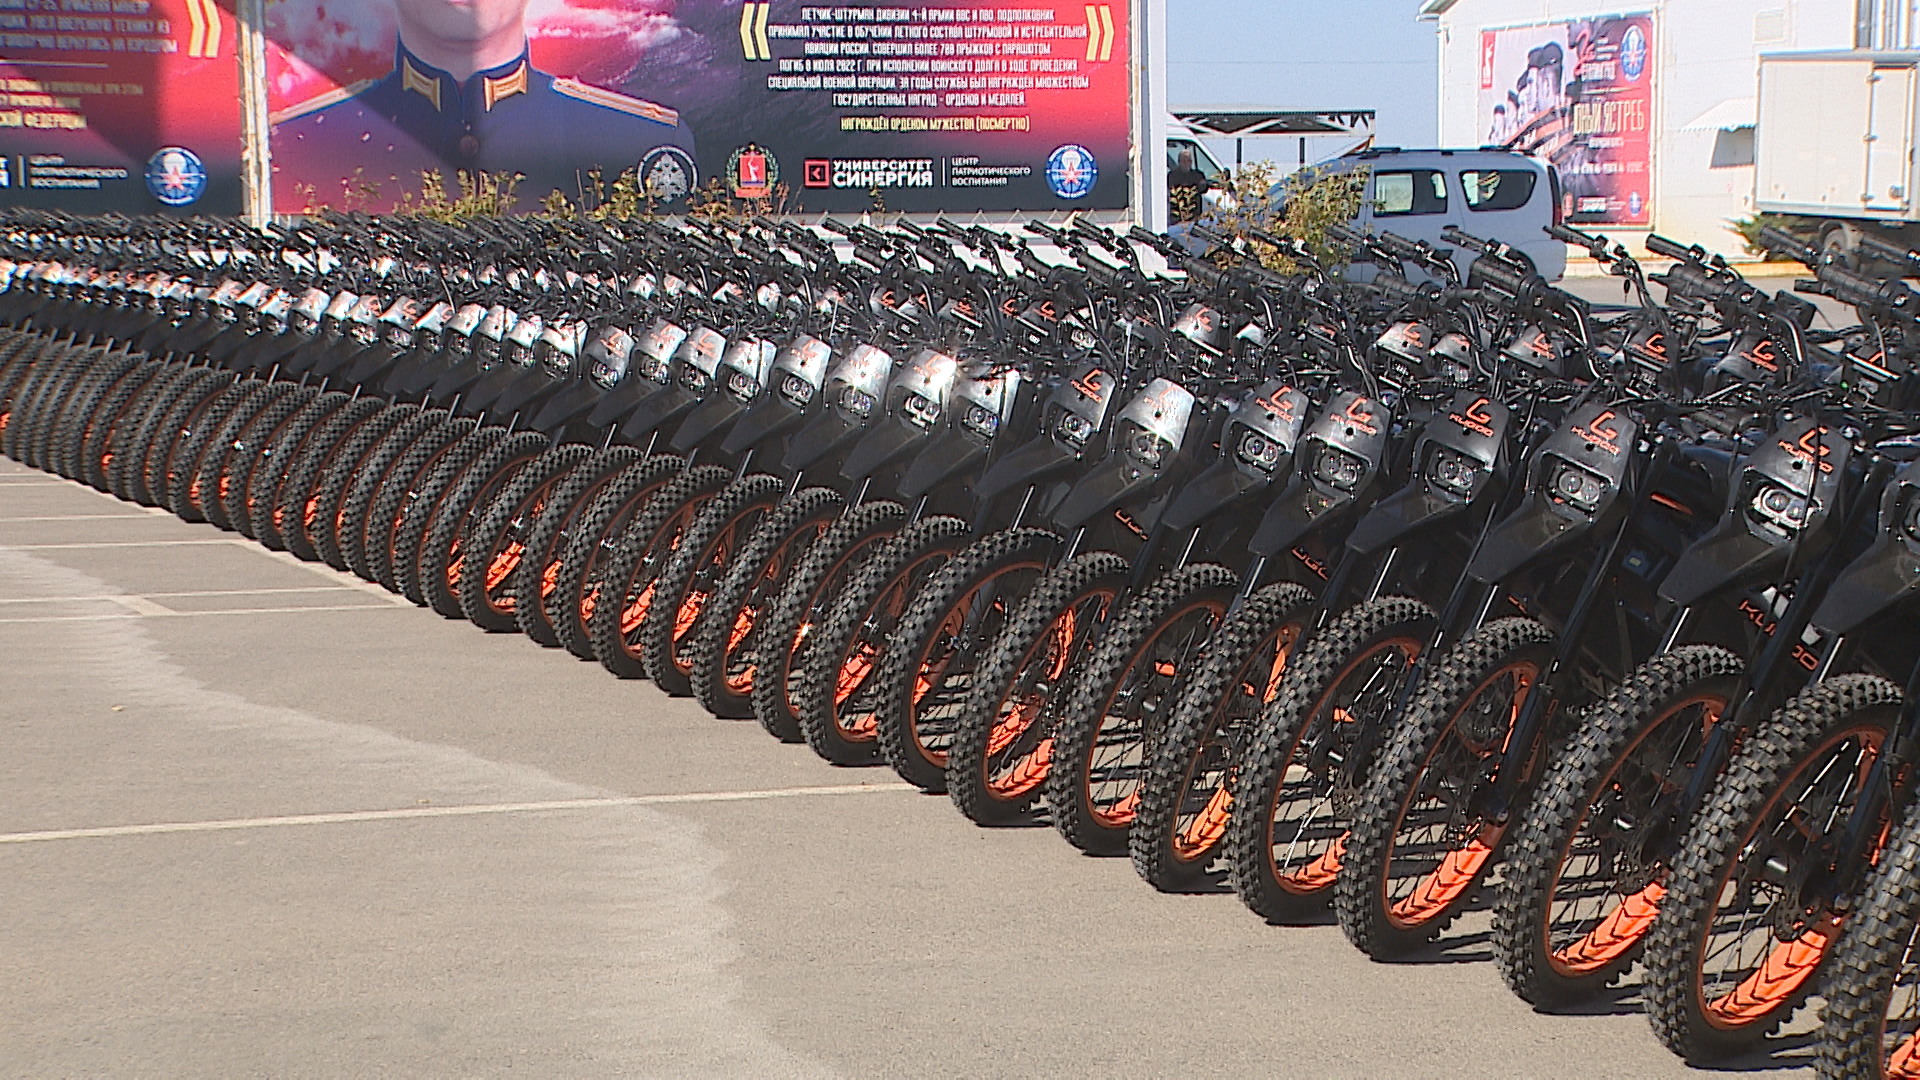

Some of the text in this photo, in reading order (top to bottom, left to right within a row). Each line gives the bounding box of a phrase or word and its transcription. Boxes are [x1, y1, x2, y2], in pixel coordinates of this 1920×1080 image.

[876, 8, 909, 21] ДИВИЗИИ
[928, 8, 954, 21] АРМИИ
[956, 8, 971, 21] ВВС
[972, 8, 978, 21] И
[997, 8, 1054, 21] ПОДПОЛКОВНИК
[768, 24, 1087, 38] ПРИНИМАЛ УЧАСТИЕ В ОБУЧЕНИИ ЛЕТНОГО СОСТАВА ШТУРМОВОЙ И ИСТРЕБИТЕЛЬНОЙ
[804, 42, 839, 54] АВИАЦИИ
[873, 42, 912, 54] СОВЕРШИЛ
[914, 42, 938, 54] БОЛЕЕ
[956, 42, 993, 54] ПРЫЖКОВ
[995, 42, 1001, 54] С
[779, 59, 804, 71] ПОГИБ
[813, 59, 834, 71] ИЮЛЯ
[836, 59, 856, 71] 2022
[866, 59, 881, 71] ПРИ
[883, 59, 929, 71] ИСПОЛНЕНИИ
[931, 59, 973, 71] ВОИНСКОГО
[975, 59, 1000, 71] ДОЛГА
[1001, 59, 1007, 71] В
[1009, 59, 1028, 71] ХОДЕ
[1030, 59, 1077, 71] ПРОВЕДЕНИЯ
[768, 75, 821, 89] СПЕЦИАЛЬНОЙ
[823, 75, 856, 89] ВОЕННОЙ
[899, 77, 909, 89] ЗА
[911, 77, 932, 89] ГОДЫ
[934, 77, 968, 89] СЛУЖБЫ
[969, 77, 986, 89] БЫЛ
[988, 77, 1034, 89] НАГРАЖДЕН
[1035, 77, 1088, 89] МНОЖЕСТВОМ
[833, 93, 906, 106] ГОСУДАРСТВЕННЫХ
[908, 93, 937, 106] НАГРАД
[946, 93, 979, 106] ОРДЕНОВ
[981, 93, 987, 106] И
[1603, 99, 1645, 133] ЯСТРЕБ
[841, 115, 1030, 131] НАГРАЖДЁН ОРДЕНОМ МУЖЕСТВА (ПОСМЕРТНО)
[834, 159, 933, 171] УНИВЕРСИТЕТ
[952, 157, 979, 166] ЦЕНТР
[952, 167, 1031, 176] ПАТРИОТИЧЕСКОГО
[833, 171, 933, 188] СИНЕРГИЯ
[952, 177, 1008, 187] ВОСПИТАНИЯ
